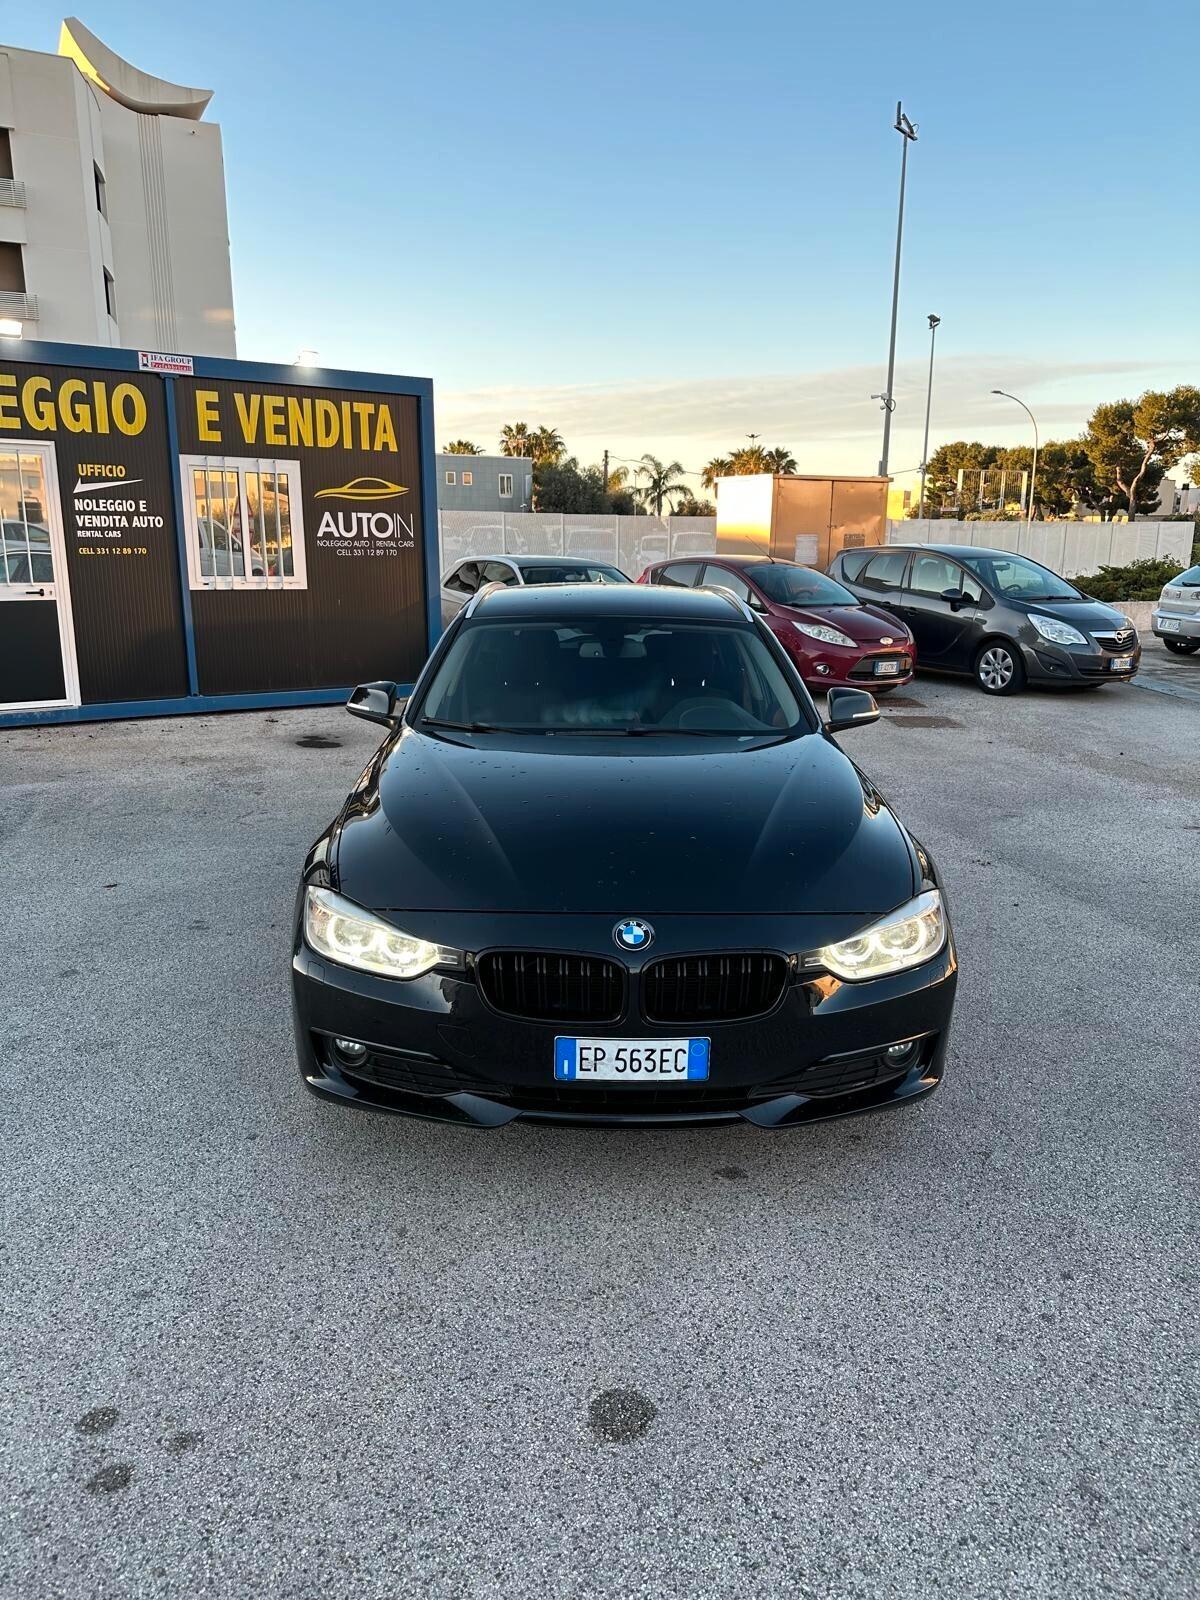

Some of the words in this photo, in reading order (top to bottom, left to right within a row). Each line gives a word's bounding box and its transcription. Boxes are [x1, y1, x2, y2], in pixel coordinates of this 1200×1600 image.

[164, 355, 192, 364] GROUP
[0, 374, 147, 436] EGGIO
[195, 390, 222, 442] E
[233, 392, 399, 452] VENDITA
[78, 463, 126, 477] UFFICIO
[74, 498, 136, 512] NOLEGGIO
[139, 500, 147, 512] E
[75, 515, 129, 528] VENDITA
[132, 516, 164, 528] AUTO
[316, 511, 414, 538] AUTOIN
[77, 530, 103, 538] RENTAL
[104, 530, 122, 538] CARS
[317, 540, 353, 548] NOLEGGIO
[353, 540, 370, 548] AUTO
[375, 540, 397, 548] RENTAL
[397, 540, 415, 548] CARS
[78, 547, 95, 555] CELL
[96, 547, 110, 555] 331
[112, 547, 121, 555] 12
[122, 547, 132, 555] 89
[133, 547, 147, 555] 170
[618, 920, 649, 931] BMW
[579, 1046, 606, 1072] EP
[615, 1048, 687, 1073] 563EC
